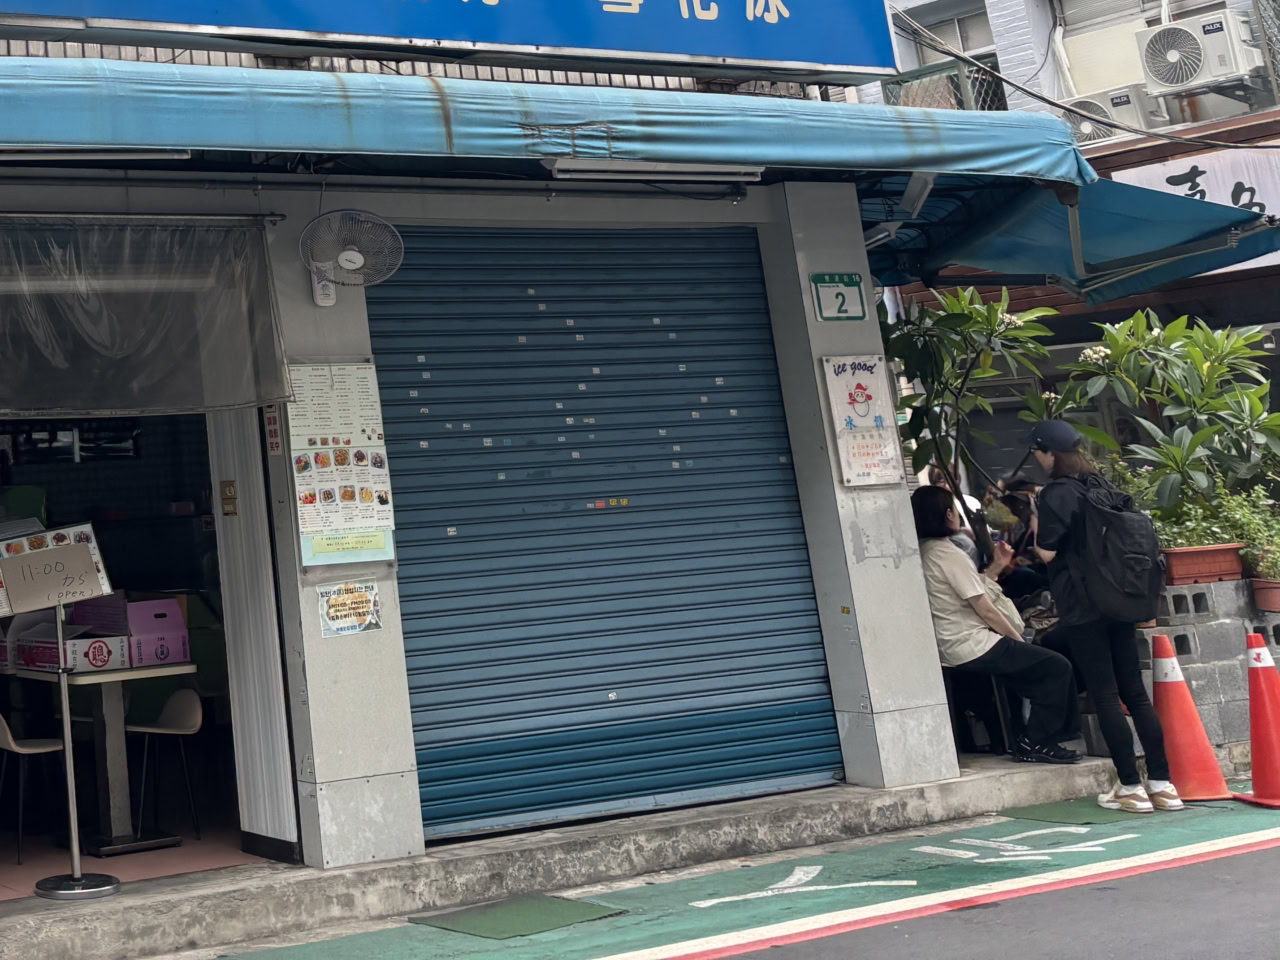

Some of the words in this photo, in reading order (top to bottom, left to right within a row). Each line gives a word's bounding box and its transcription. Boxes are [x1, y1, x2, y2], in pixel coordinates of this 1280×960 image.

[1204, 22, 1222, 31] AUX
[835, 291, 848, 314] 2
[850, 361, 877, 376] good
[21, 561, 65, 581] 11:00
